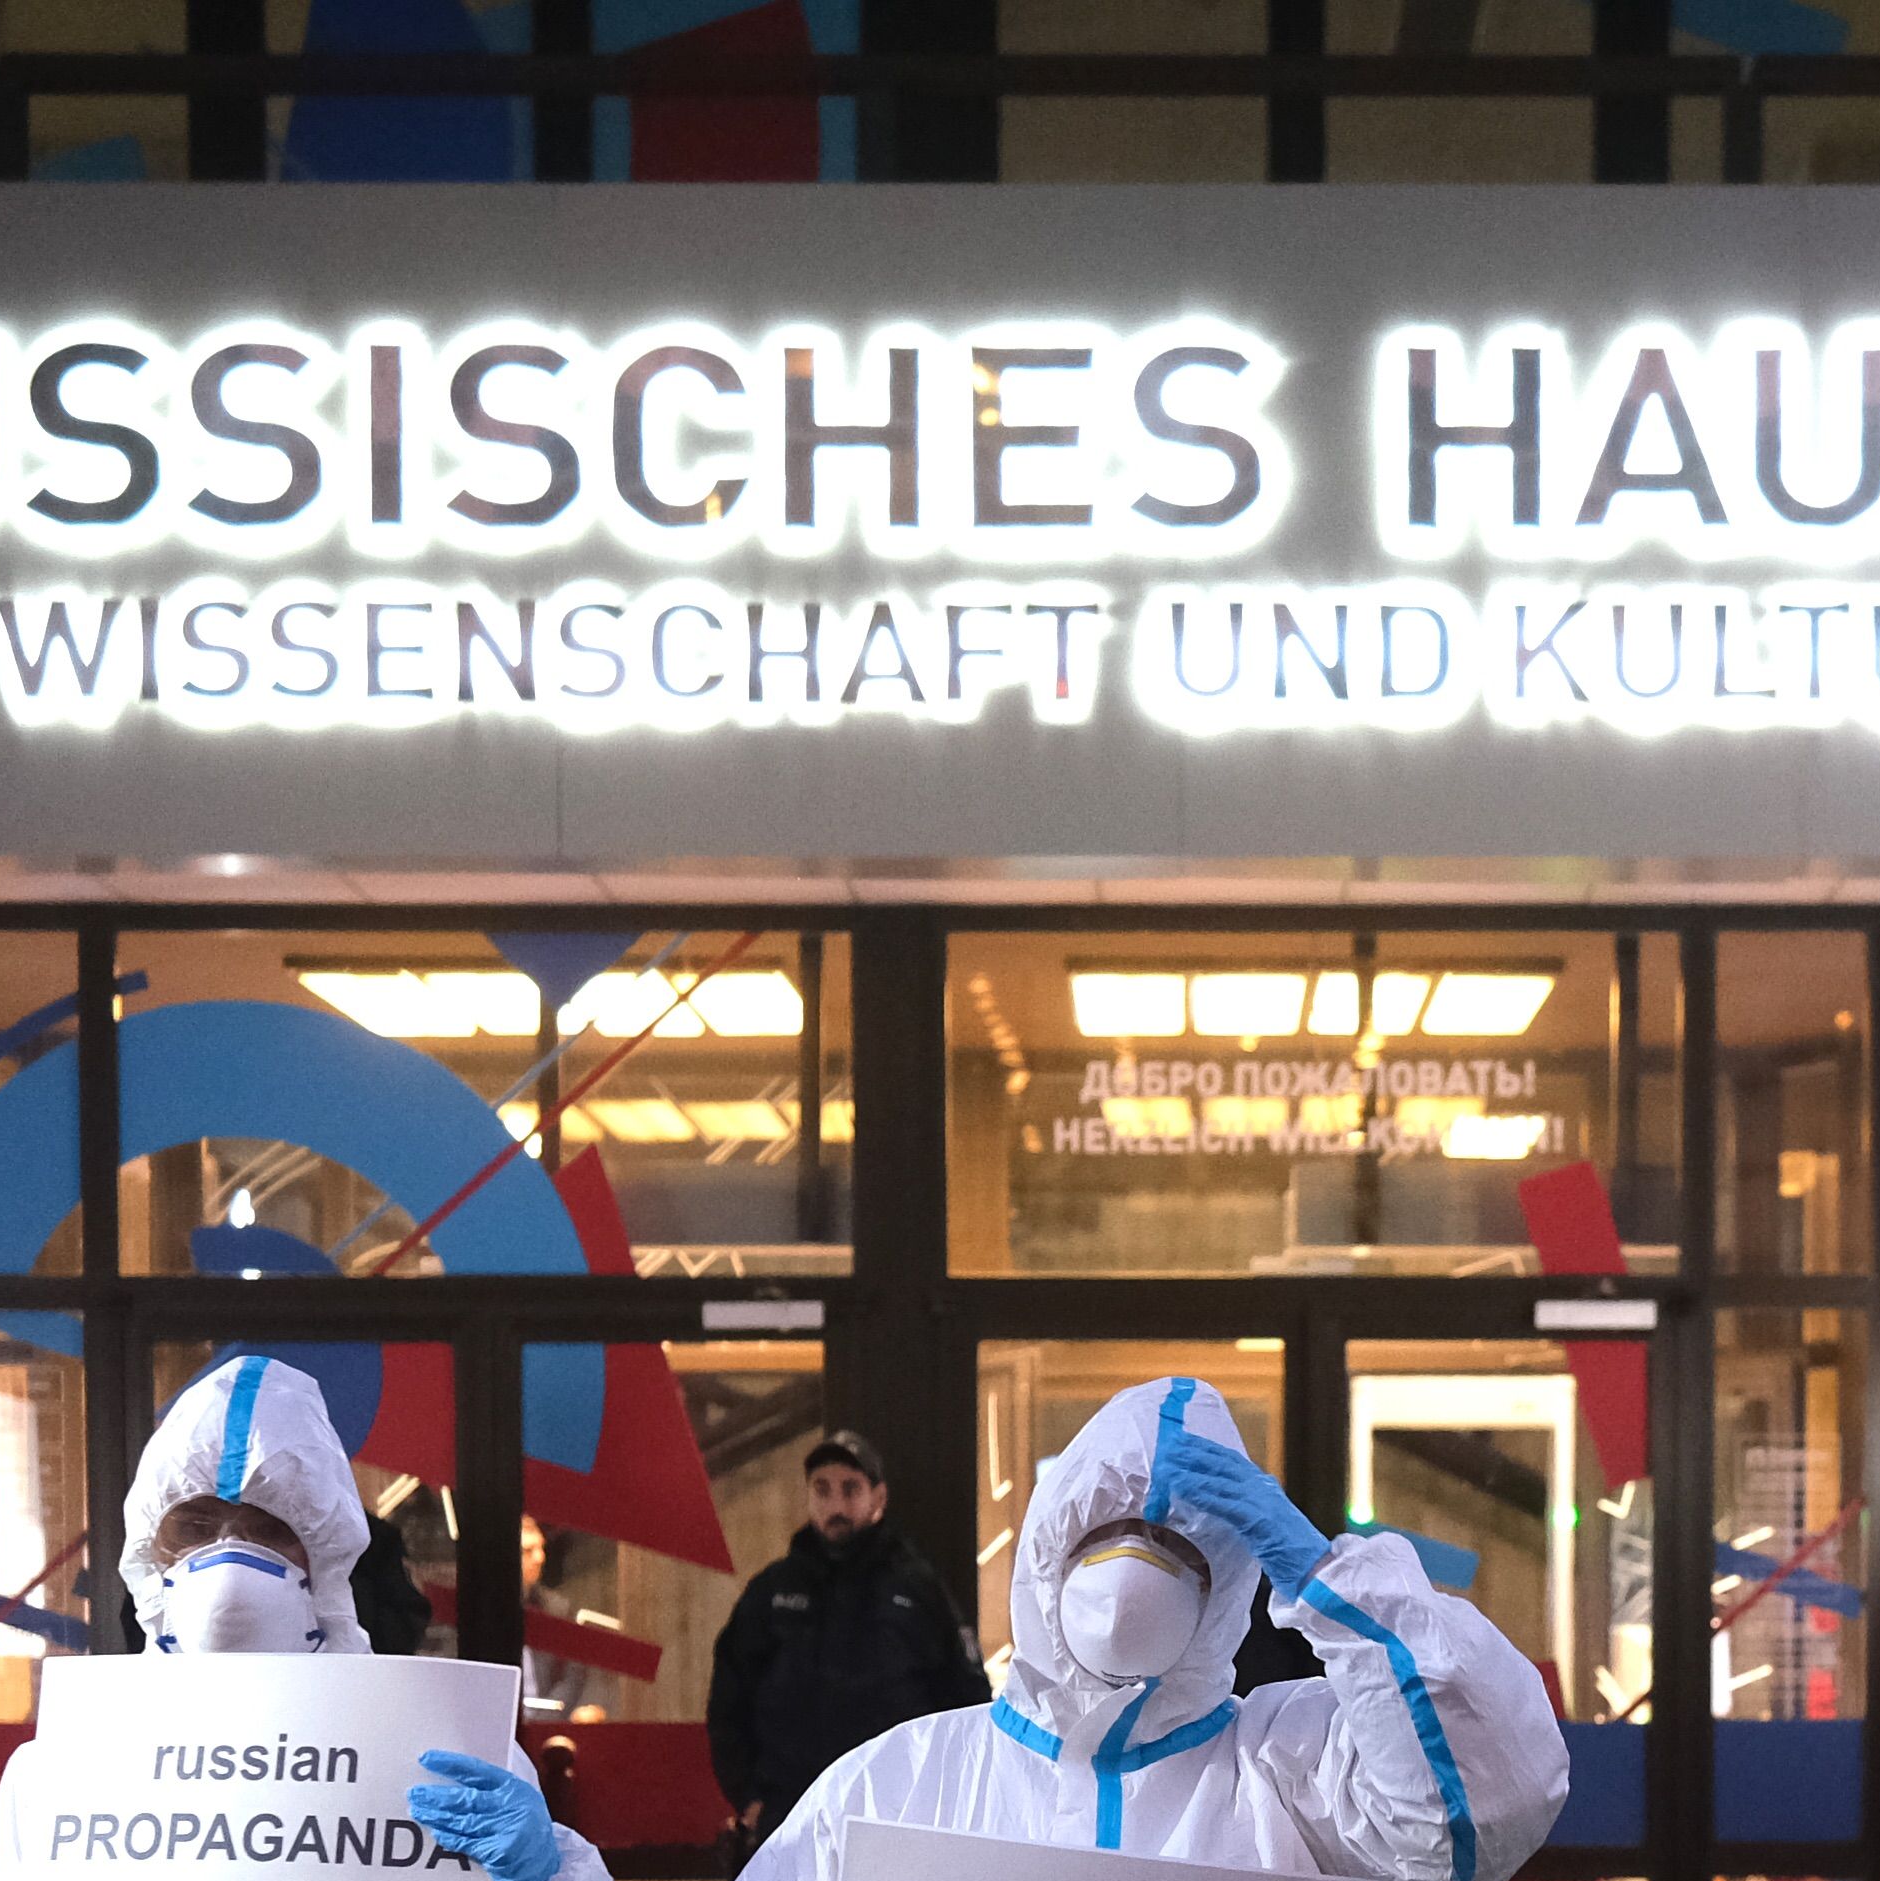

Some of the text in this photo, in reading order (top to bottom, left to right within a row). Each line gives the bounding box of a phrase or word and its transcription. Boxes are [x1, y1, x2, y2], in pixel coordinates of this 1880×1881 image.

[1170, 597, 1452, 703] UND
[1079, 1059, 1537, 1104] ДОБРО ПОЖАЛОВАТЬ!
[152, 1734, 359, 1784] russian
[49, 1812, 472, 1872] PROPAGANDA
